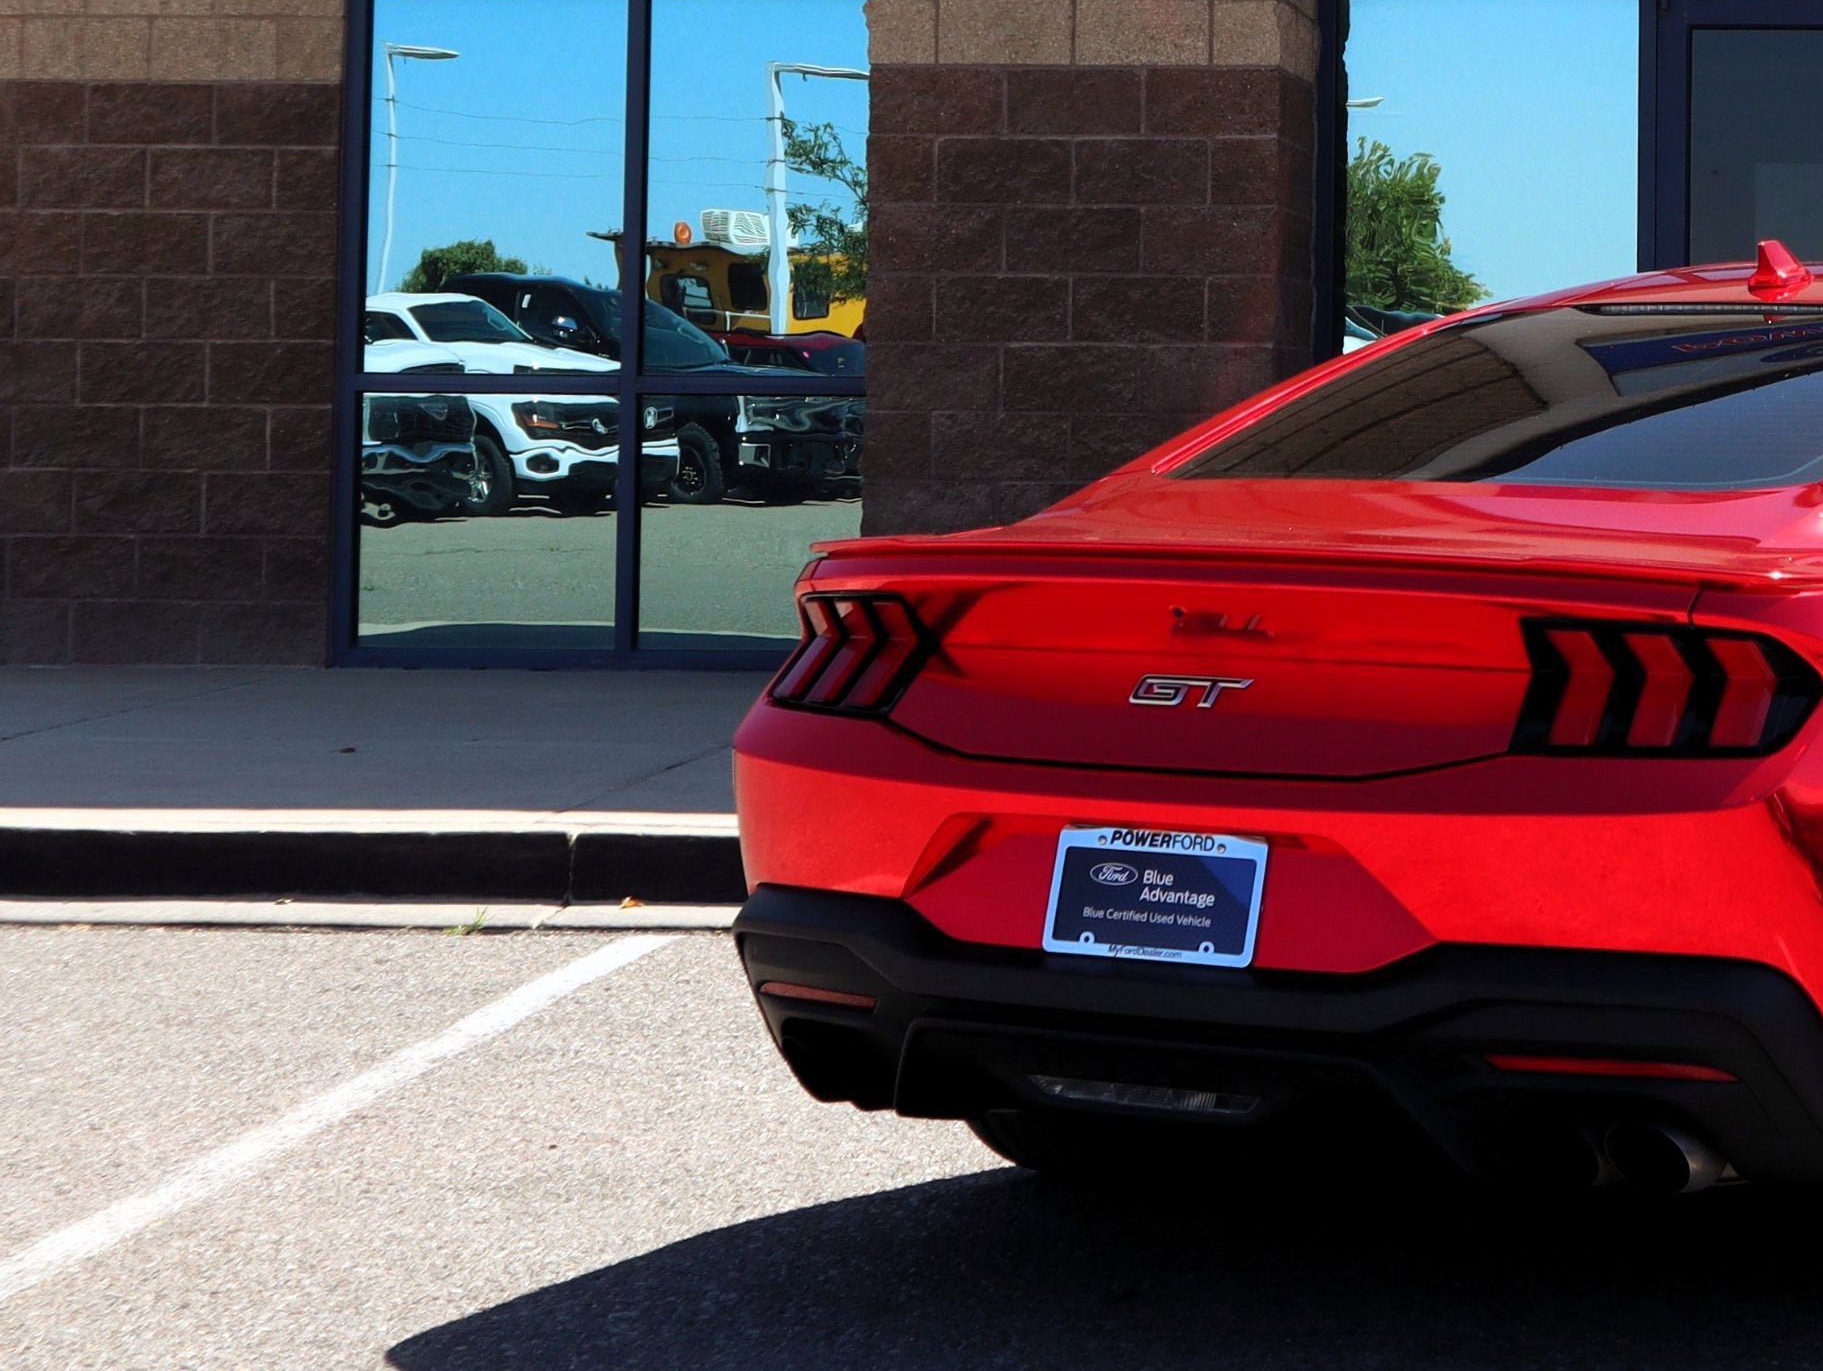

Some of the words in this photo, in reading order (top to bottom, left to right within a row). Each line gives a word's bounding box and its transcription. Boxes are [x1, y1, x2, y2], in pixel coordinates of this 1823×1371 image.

[1128, 673, 1255, 709] GT
[1110, 829, 1216, 852] POWERFORD
[1098, 865, 1130, 883] Ford
[1142, 869, 1174, 886] Blue
[1139, 886, 1216, 909] Advantage
[1082, 906, 1105, 919] Blue
[1105, 908, 1148, 923] Certified
[1149, 912, 1175, 925] Used
[1176, 915, 1212, 928] Vehicle
